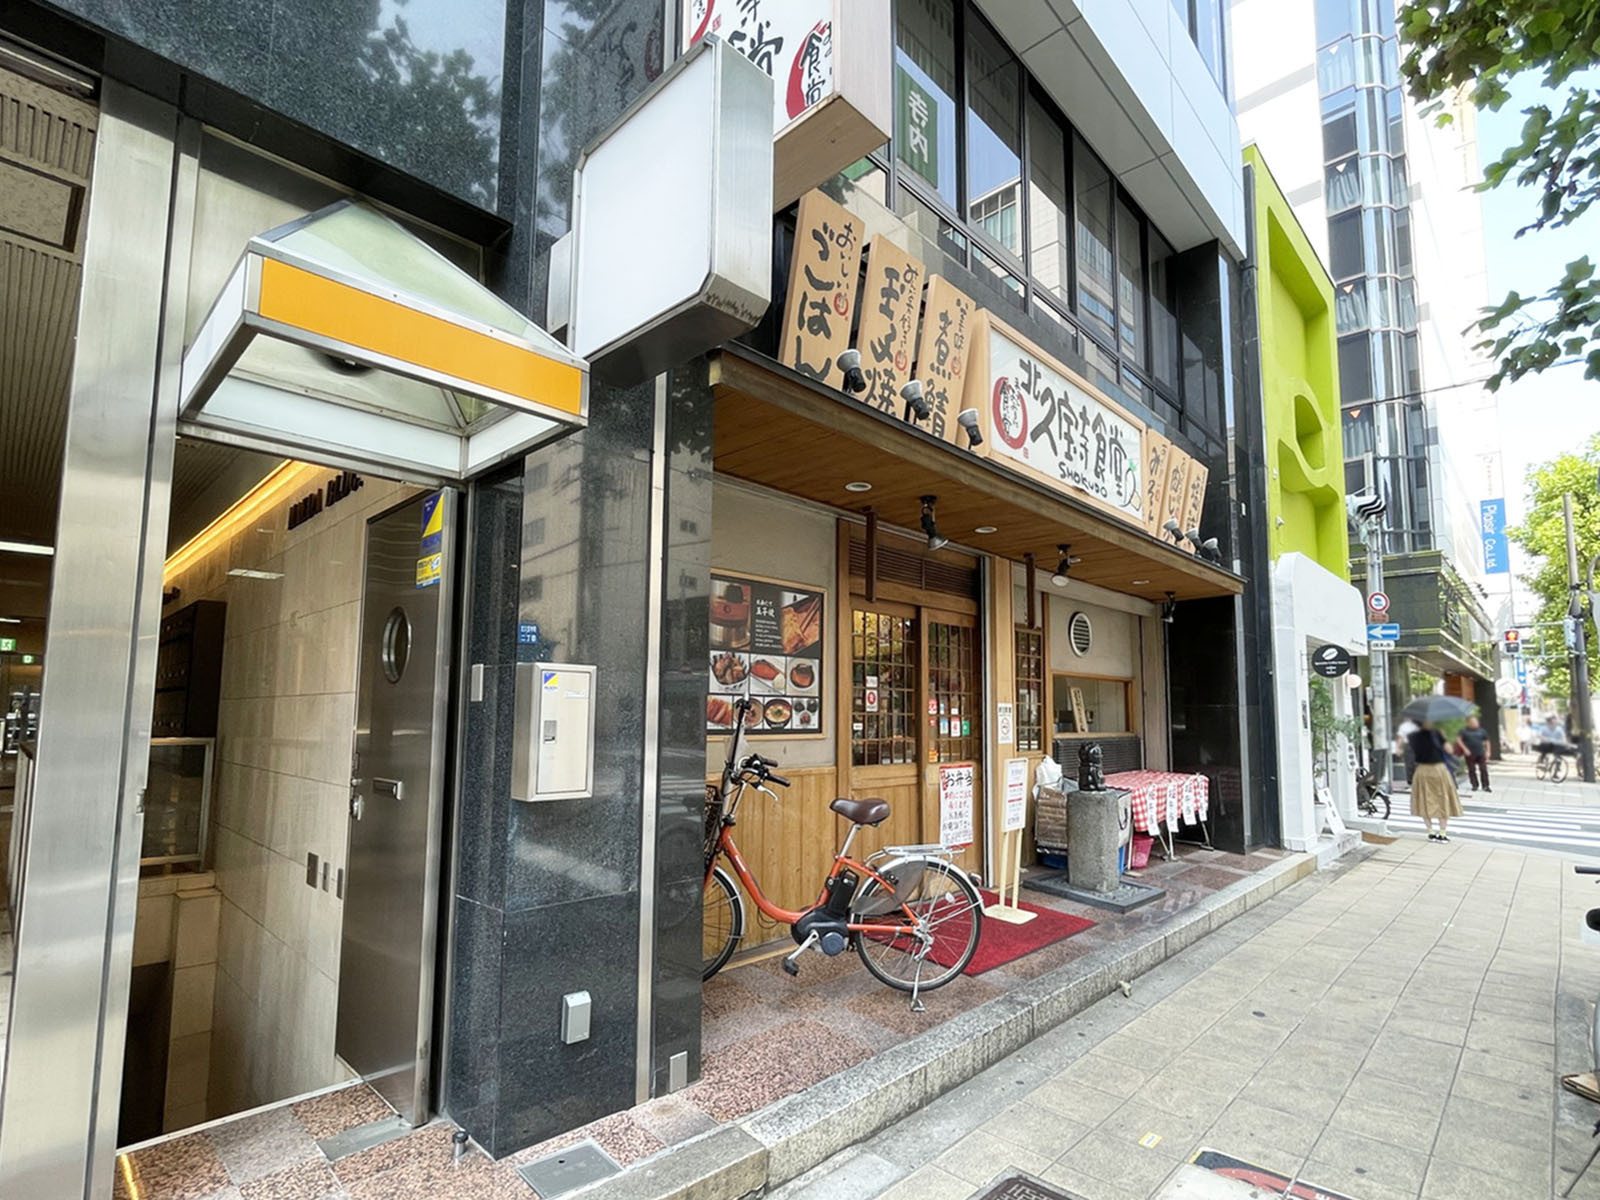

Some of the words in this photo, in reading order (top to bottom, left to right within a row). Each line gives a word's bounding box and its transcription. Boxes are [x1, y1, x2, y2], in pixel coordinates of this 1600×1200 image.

[794, 222, 834, 382] ごはん
[835, 222, 857, 290] おいしい
[864, 266, 906, 417] 玉子焼
[1018, 357, 1128, 498] 北久宝寺食堂
[1058, 461, 1108, 499] SHOKUDO
[944, 770, 973, 787] お弁当
